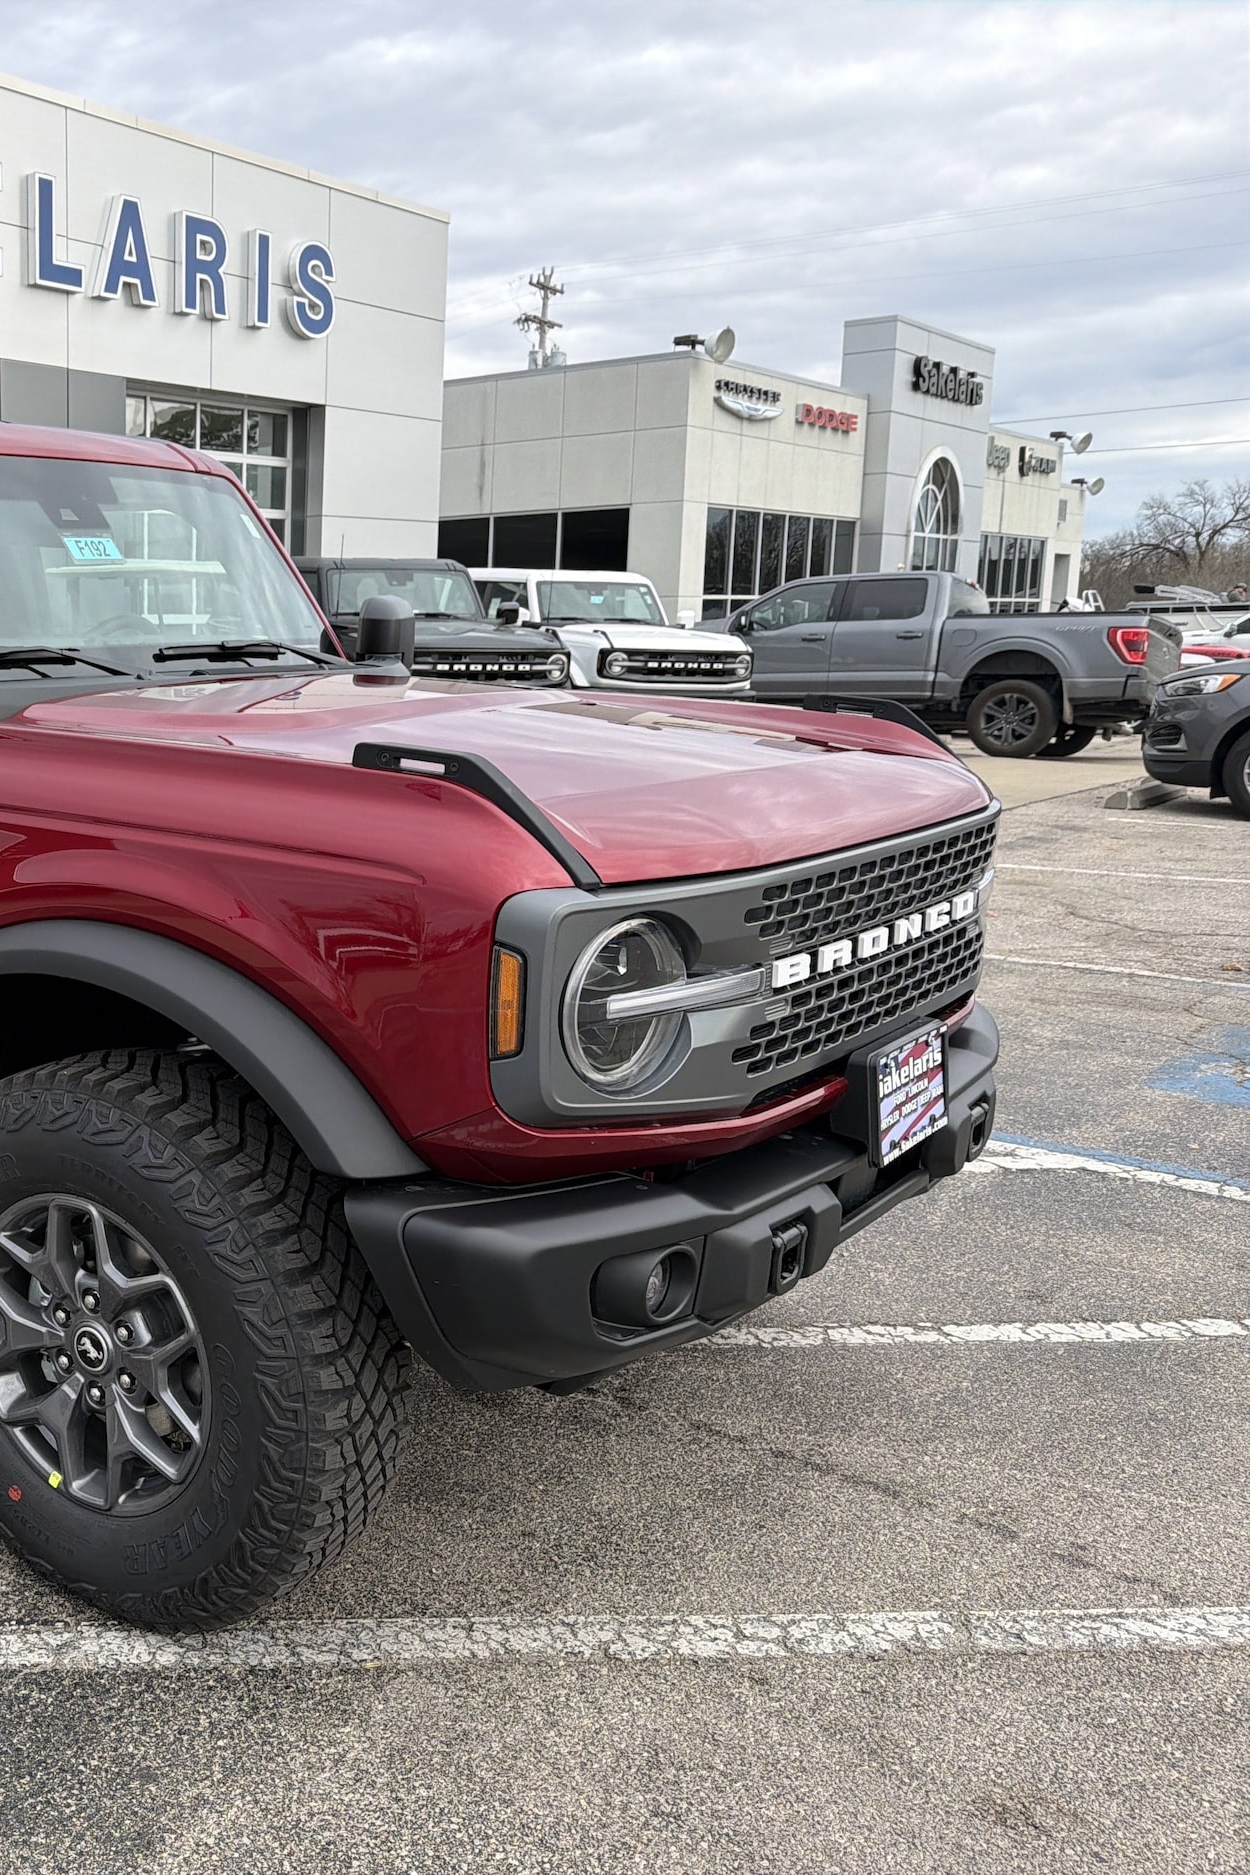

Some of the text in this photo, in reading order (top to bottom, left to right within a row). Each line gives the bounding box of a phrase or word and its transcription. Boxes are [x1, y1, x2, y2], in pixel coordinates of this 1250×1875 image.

[915, 356, 983, 406] Sakelaris
[799, 404, 858, 432] DODGE
[987, 436, 1010, 473] Jeep
[75, 539, 111, 557] F192
[436, 662, 531, 672] BRONCO
[647, 661, 724, 669] BRONCO
[772, 891, 974, 988] BRONCO
